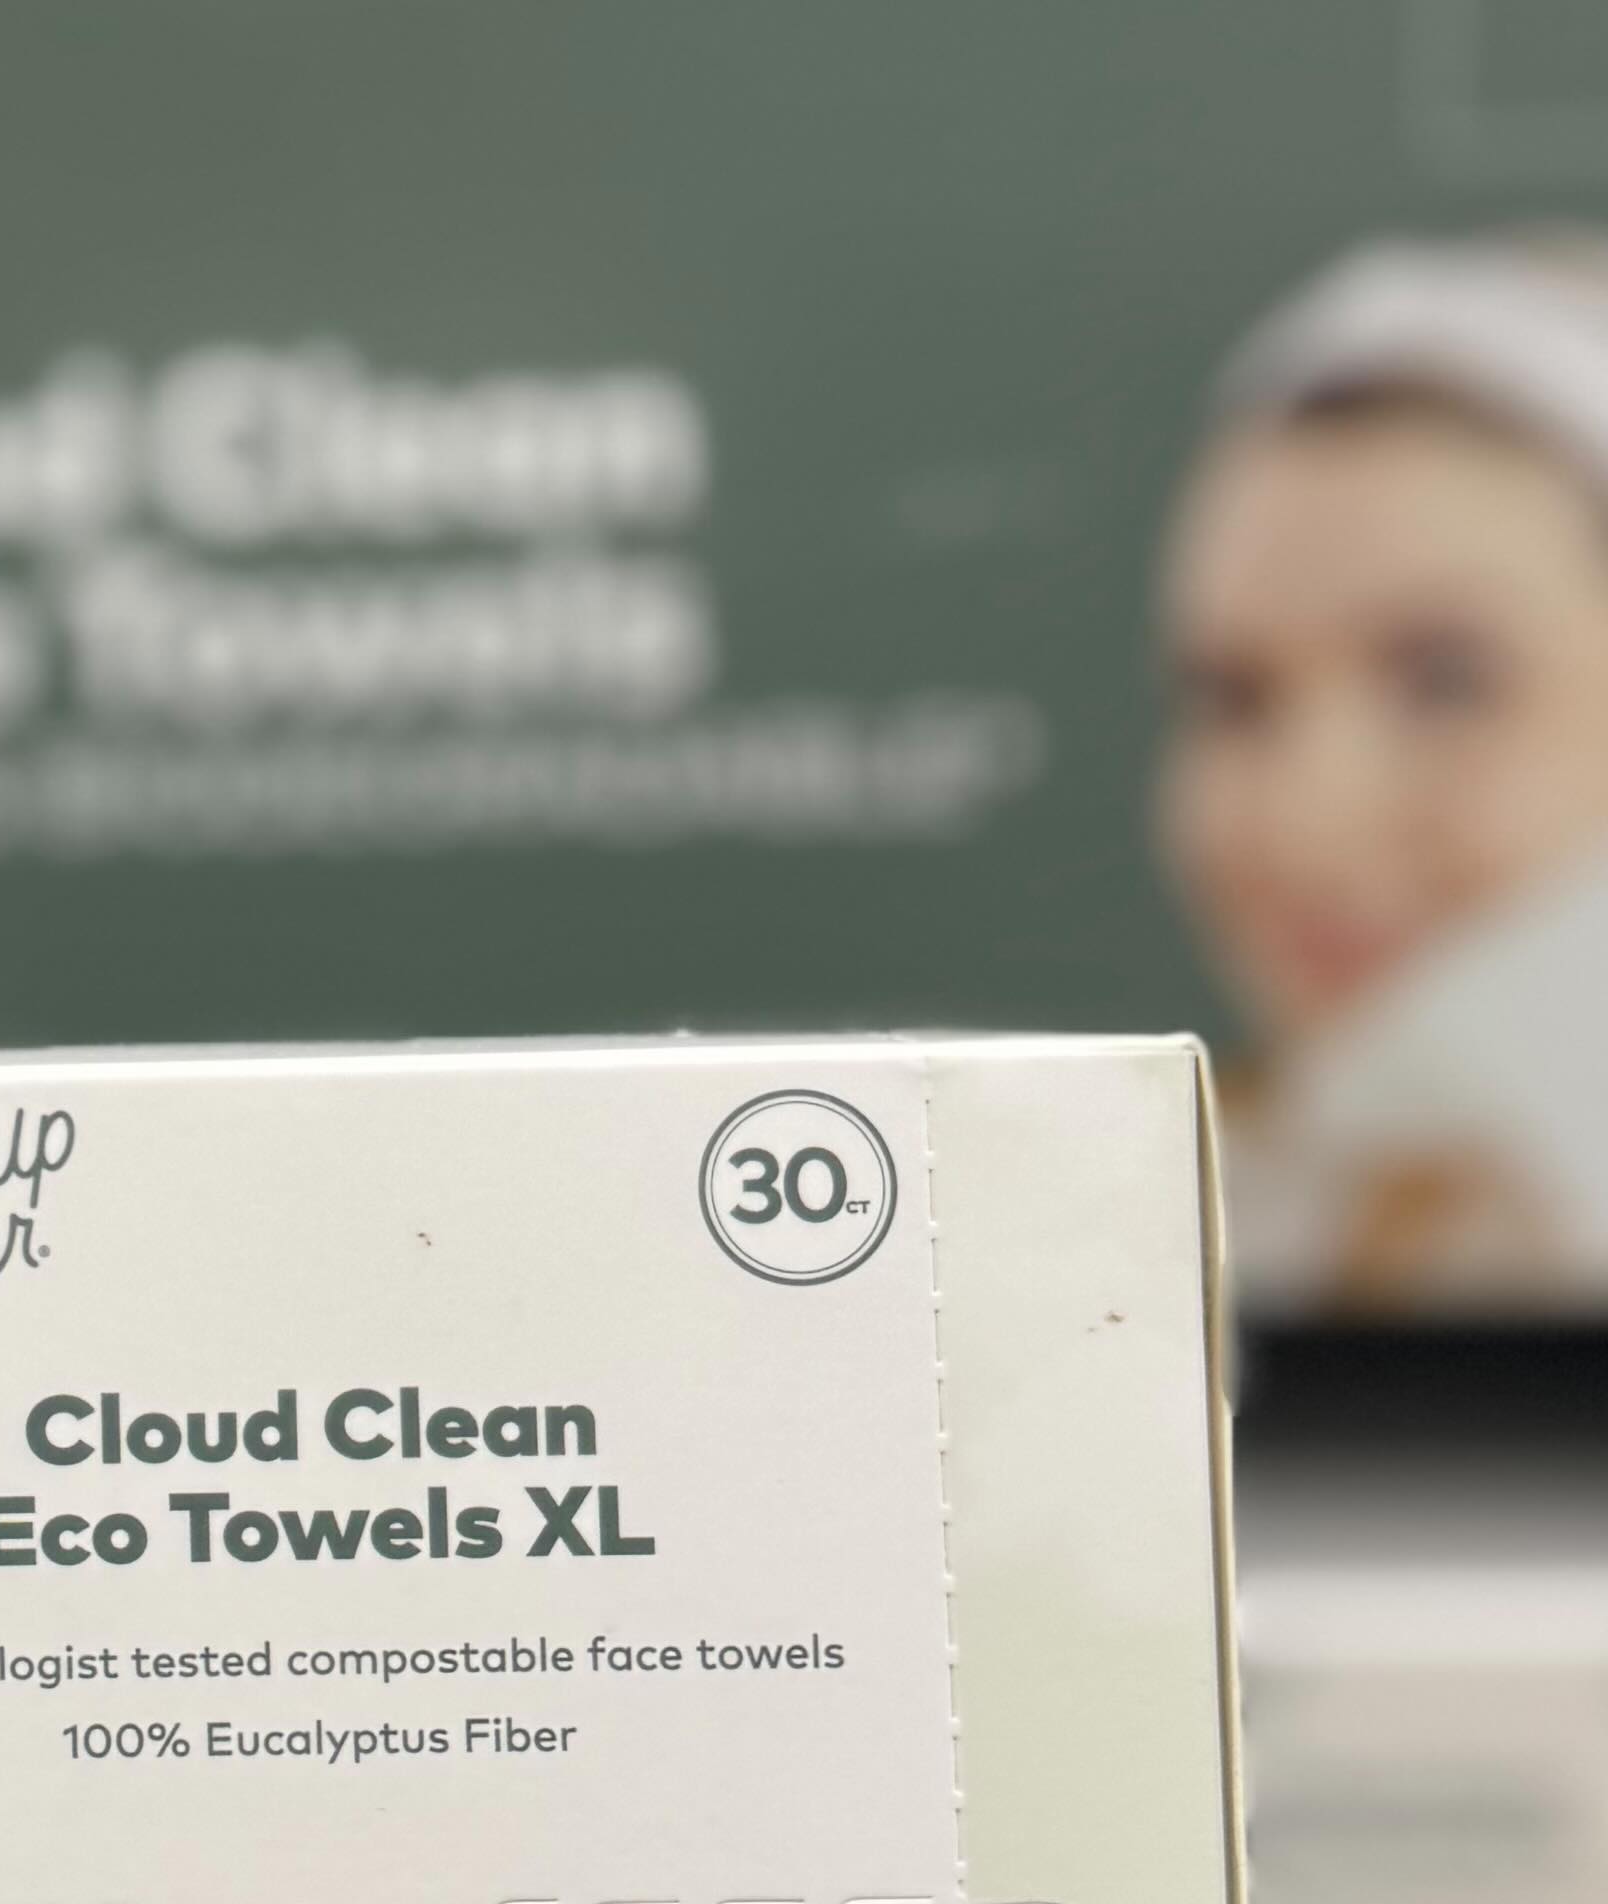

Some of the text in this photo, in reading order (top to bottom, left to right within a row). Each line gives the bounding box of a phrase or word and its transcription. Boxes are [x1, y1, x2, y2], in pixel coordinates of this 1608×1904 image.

[154, 341, 704, 536] Clean
[70, 546, 707, 718] Towels
[727, 1146, 871, 1225] 30 CT
[24, 1385, 597, 1467] Cloud Clean
[168, 1486, 503, 1563] Towels
[524, 1485, 656, 1558] XL
[130, 1640, 273, 1679] tested
[286, 1636, 575, 1684] compostable
[586, 1634, 684, 1672] face
[695, 1632, 846, 1671] towels
[61, 1715, 579, 1765] 100% Eucalyptus Fiber
